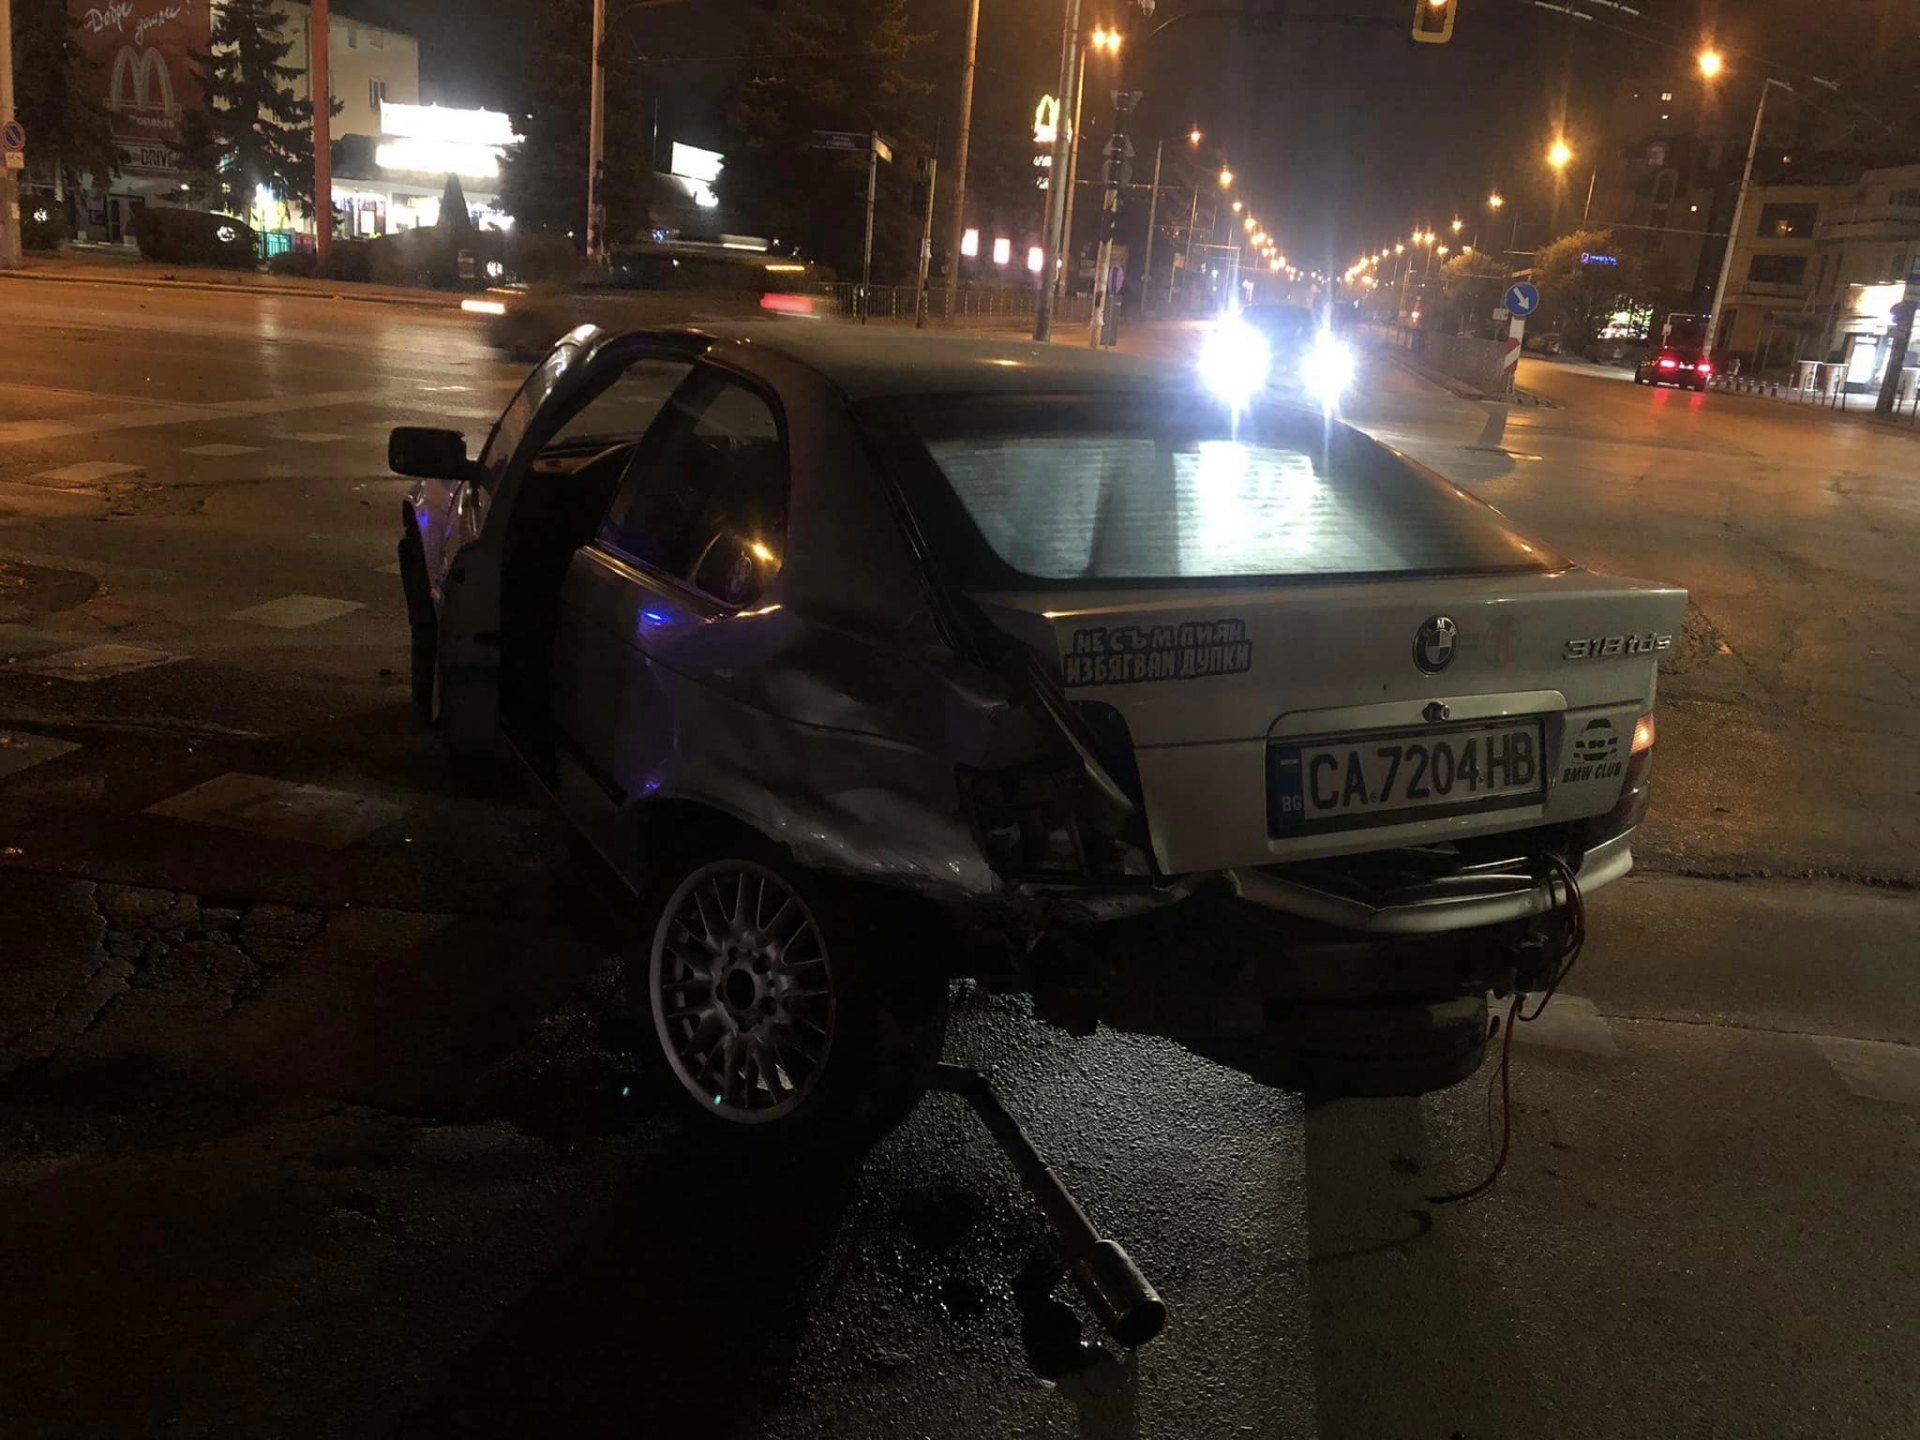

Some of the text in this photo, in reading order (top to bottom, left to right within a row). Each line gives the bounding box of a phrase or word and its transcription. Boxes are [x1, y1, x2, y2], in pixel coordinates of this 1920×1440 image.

[1076, 621, 1244, 654] НЕ СЪМ ПИЯН
[1565, 632, 1672, 660] 318tds
[1066, 643, 1249, 685] ИЗБЯГВАМ ДУПКИ
[1562, 762, 1622, 783] BMW CLUB
[1281, 794, 1303, 812] BG
